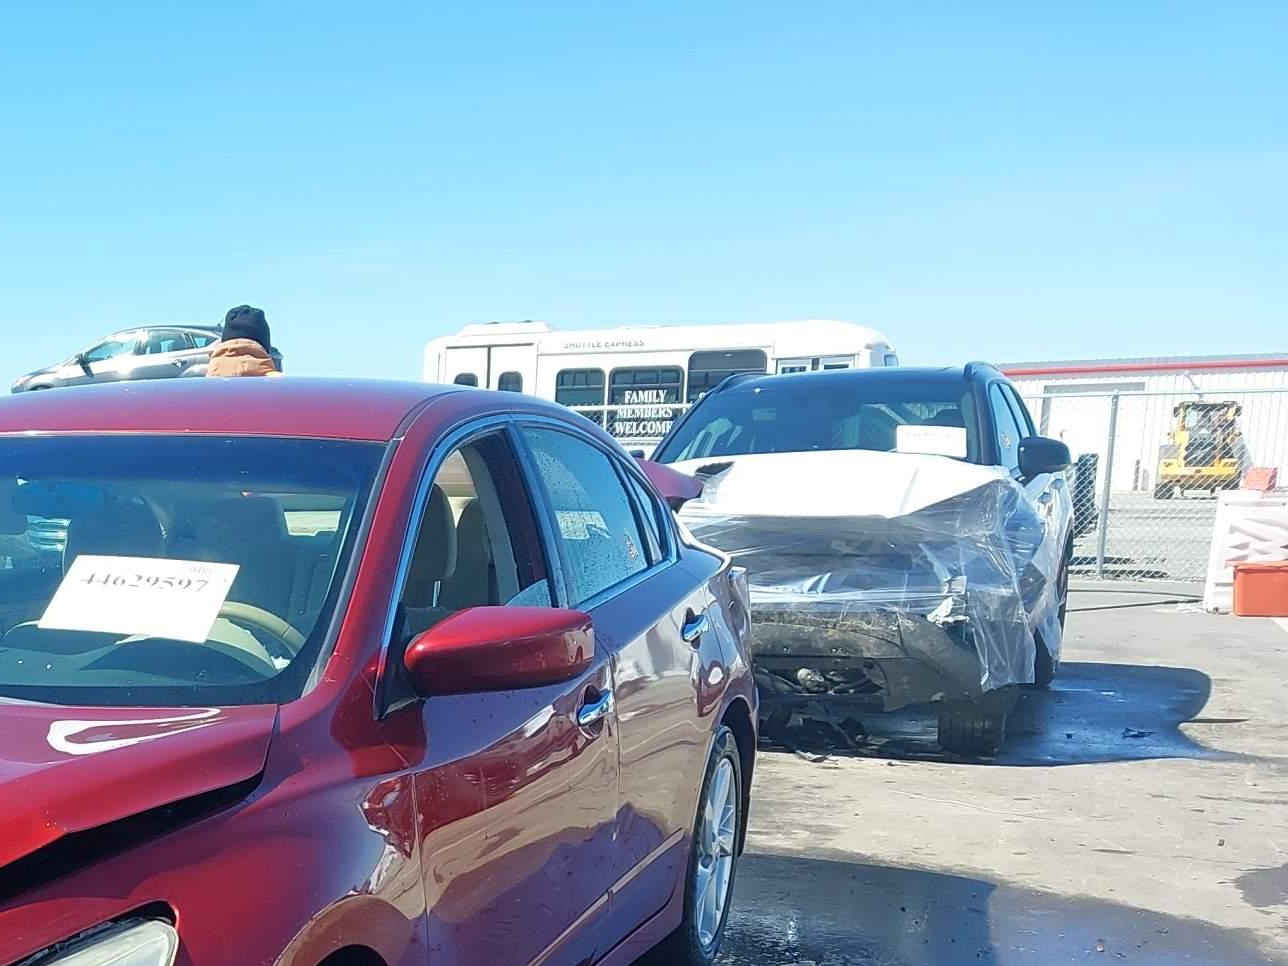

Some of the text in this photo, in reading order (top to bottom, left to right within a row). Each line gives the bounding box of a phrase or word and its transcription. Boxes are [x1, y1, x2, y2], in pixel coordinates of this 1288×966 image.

[563, 339, 645, 349] SHUTTLE EXPRESS
[624, 389, 667, 404] FAMILY
[617, 407, 673, 418] MEMBERS
[80, 573, 209, 593] 44629597
